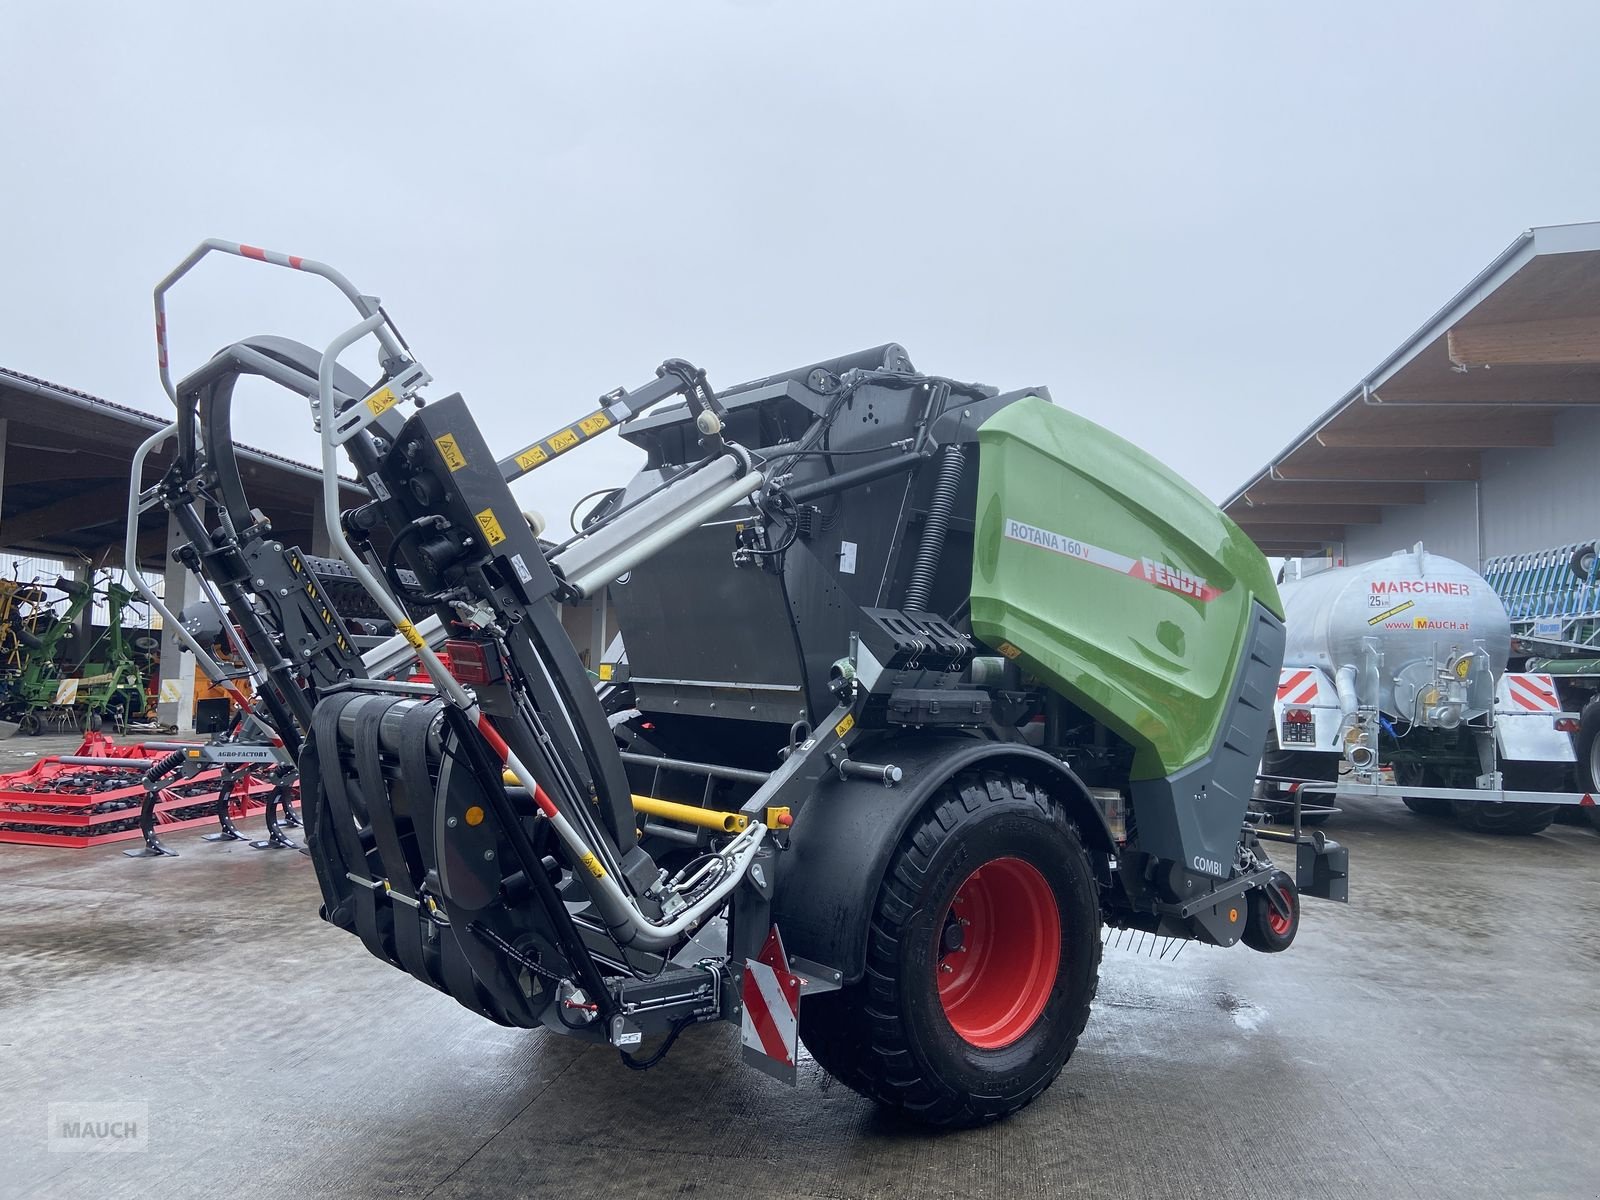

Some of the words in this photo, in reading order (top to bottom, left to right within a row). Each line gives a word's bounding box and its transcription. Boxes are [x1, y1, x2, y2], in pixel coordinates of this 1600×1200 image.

[1010, 522, 1059, 550] ROTANA
[1061, 538, 1081, 556] 160
[1141, 555, 1206, 598] FENDT
[1371, 581, 1470, 596] MARCHNER
[1369, 595, 1381, 607] 25
[1193, 855, 1222, 876] COMBI
